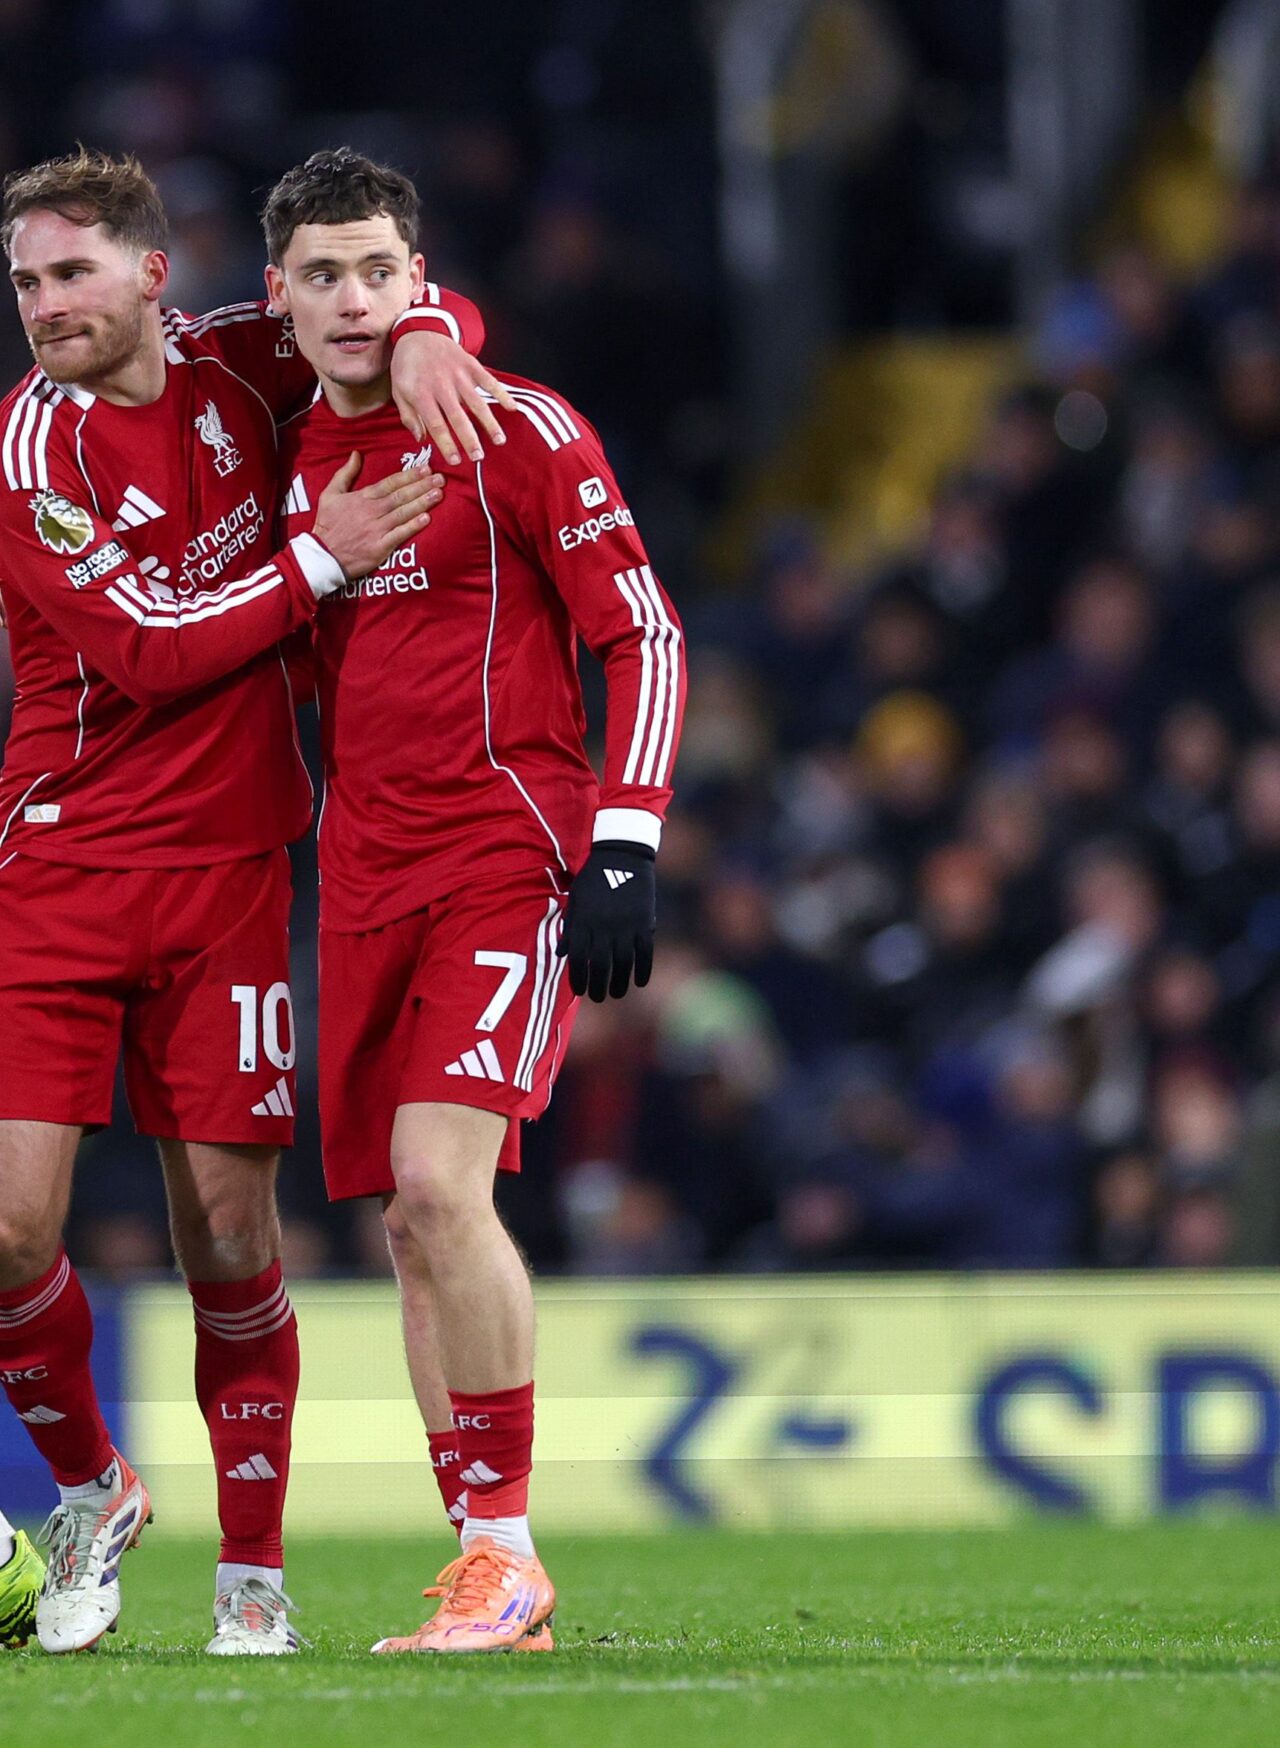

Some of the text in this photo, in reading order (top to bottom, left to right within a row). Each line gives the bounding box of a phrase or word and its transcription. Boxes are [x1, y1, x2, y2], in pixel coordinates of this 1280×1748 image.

[181, 492, 259, 568] andard
[65, 542, 120, 580] No room
[72, 549, 129, 589] for racism
[326, 567, 429, 600] artered
[474, 950, 527, 1032] 7
[231, 981, 296, 1072] 10
[221, 1403, 283, 1419] LFC
